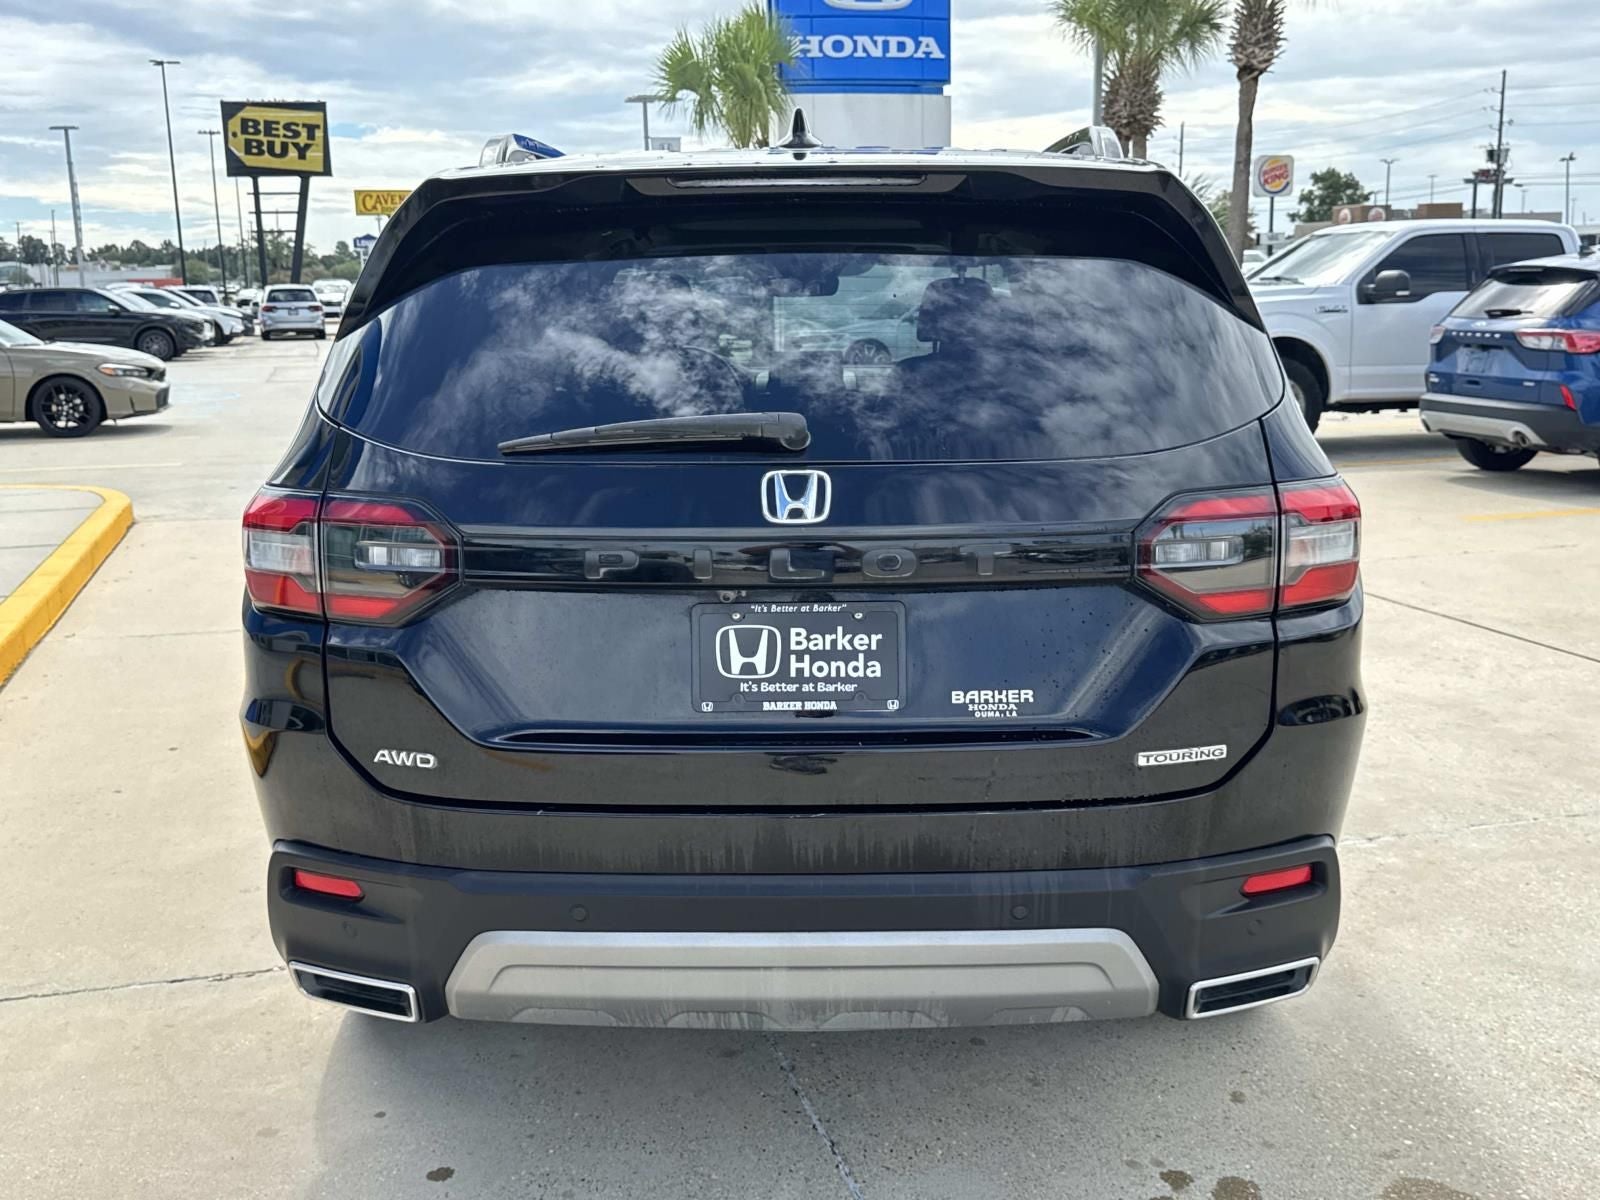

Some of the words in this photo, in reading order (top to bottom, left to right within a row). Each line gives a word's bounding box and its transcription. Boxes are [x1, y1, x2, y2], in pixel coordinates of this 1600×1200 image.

[787, 34, 946, 59] HONDA
[240, 117, 321, 141] BEST
[244, 138, 315, 161] BUY
[583, 547, 1014, 581] PILOT
[770, 604, 798, 613] Better
[800, 604, 811, 613] at
[789, 626, 883, 651] Barker
[789, 653, 882, 678] Honda
[740, 681, 759, 692] It's
[760, 682, 800, 692] Better
[801, 682, 816, 692] at
[817, 682, 858, 692] Barker
[951, 689, 1034, 704] BARKER
[762, 701, 803, 711] BARKER
[803, 701, 838, 711] HONDA
[967, 703, 1018, 711] HONDA
[373, 749, 438, 769] AWD
[1140, 747, 1225, 765] TOURING
